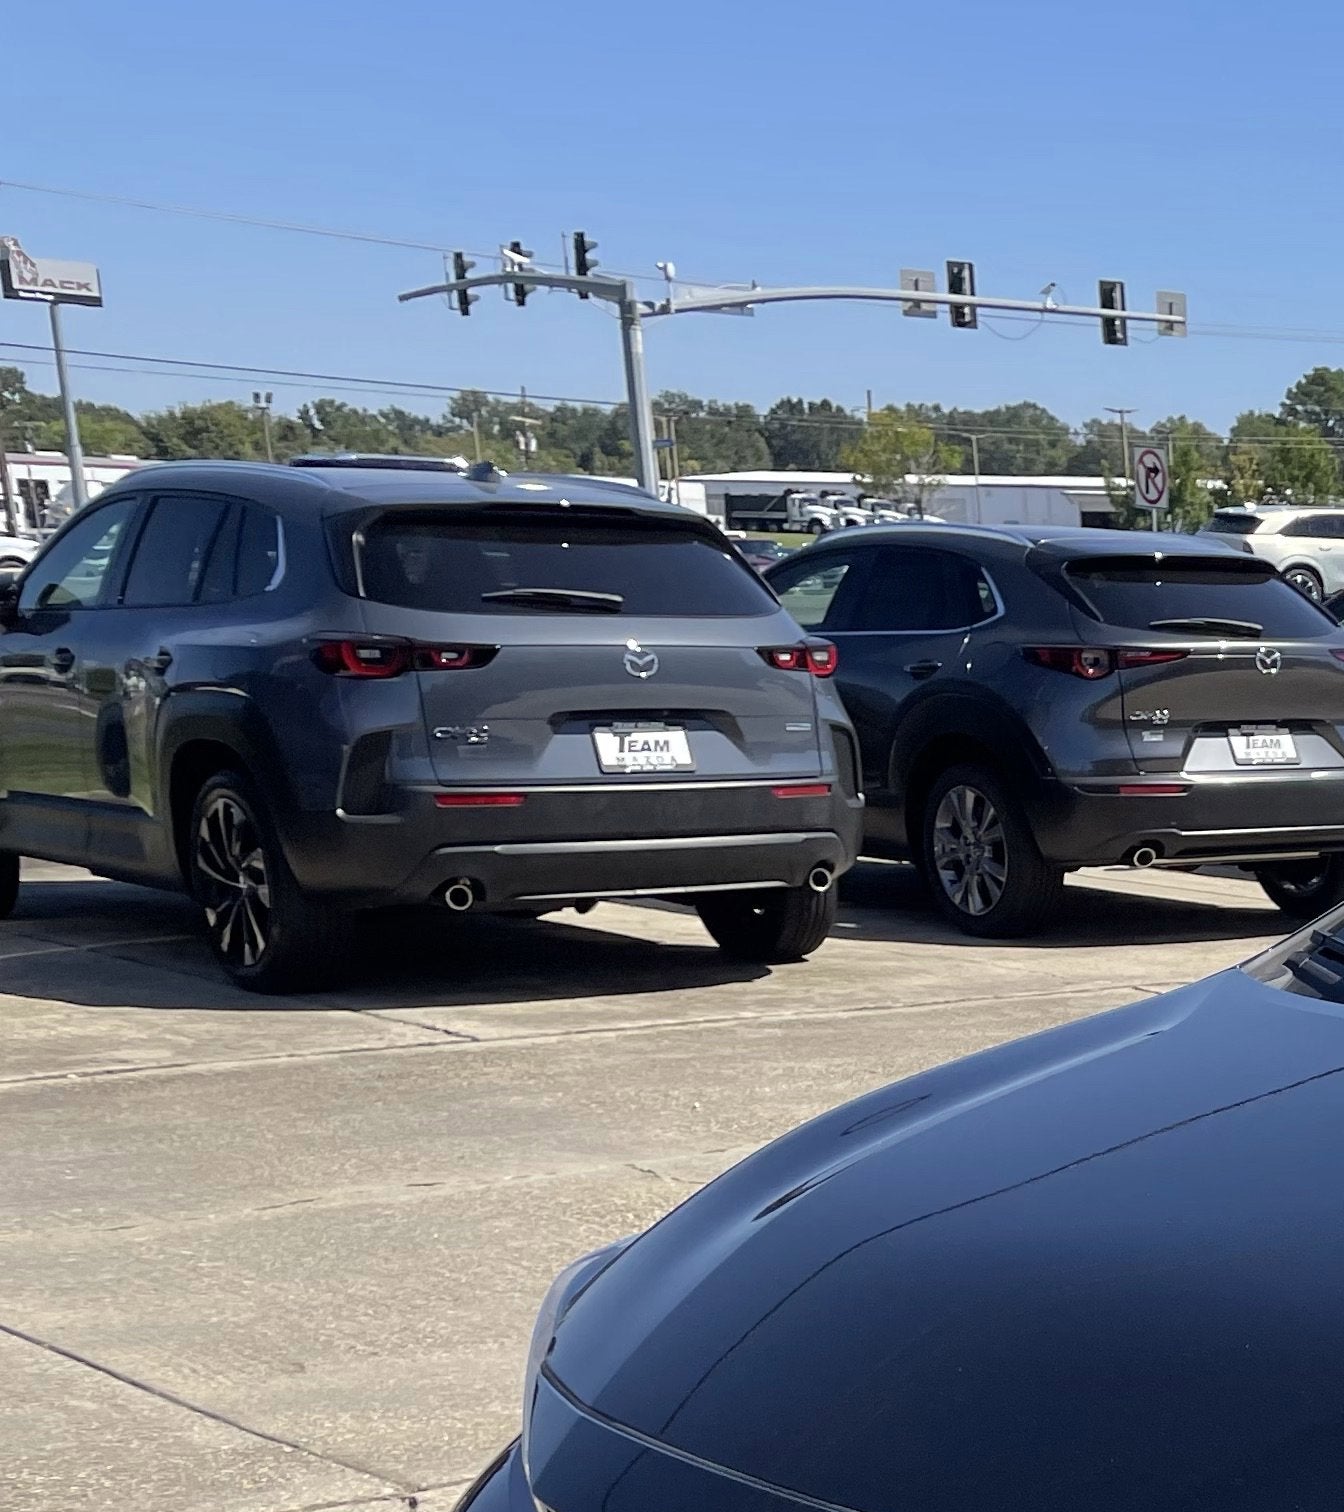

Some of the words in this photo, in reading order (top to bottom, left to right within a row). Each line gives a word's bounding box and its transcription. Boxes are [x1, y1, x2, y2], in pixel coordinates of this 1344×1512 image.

[18, 276, 93, 293] MACK
[613, 732, 670, 753] TEAM
[1240, 732, 1282, 749] TEAM
